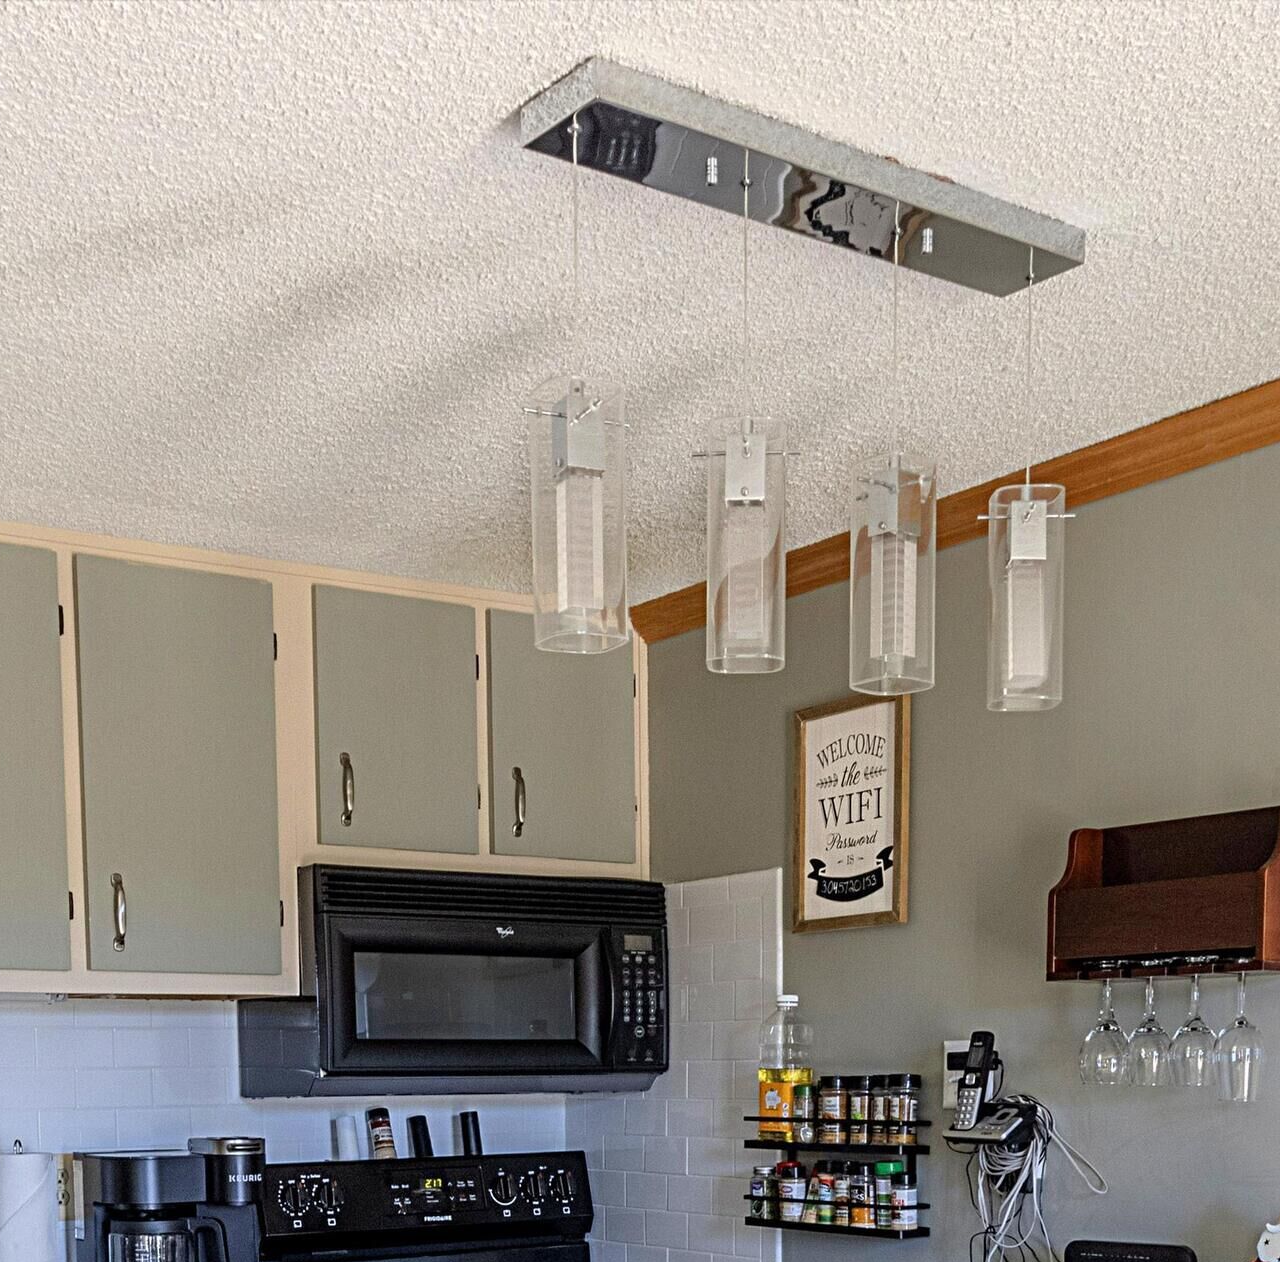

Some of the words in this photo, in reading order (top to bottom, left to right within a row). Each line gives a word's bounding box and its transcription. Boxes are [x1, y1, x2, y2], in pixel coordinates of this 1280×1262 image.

[816, 733, 886, 769] WELCOME
[840, 760, 861, 788] the
[818, 786, 883, 829] WIFI
[825, 830, 878, 852] Password
[228, 1172, 263, 1183] KEURIG
